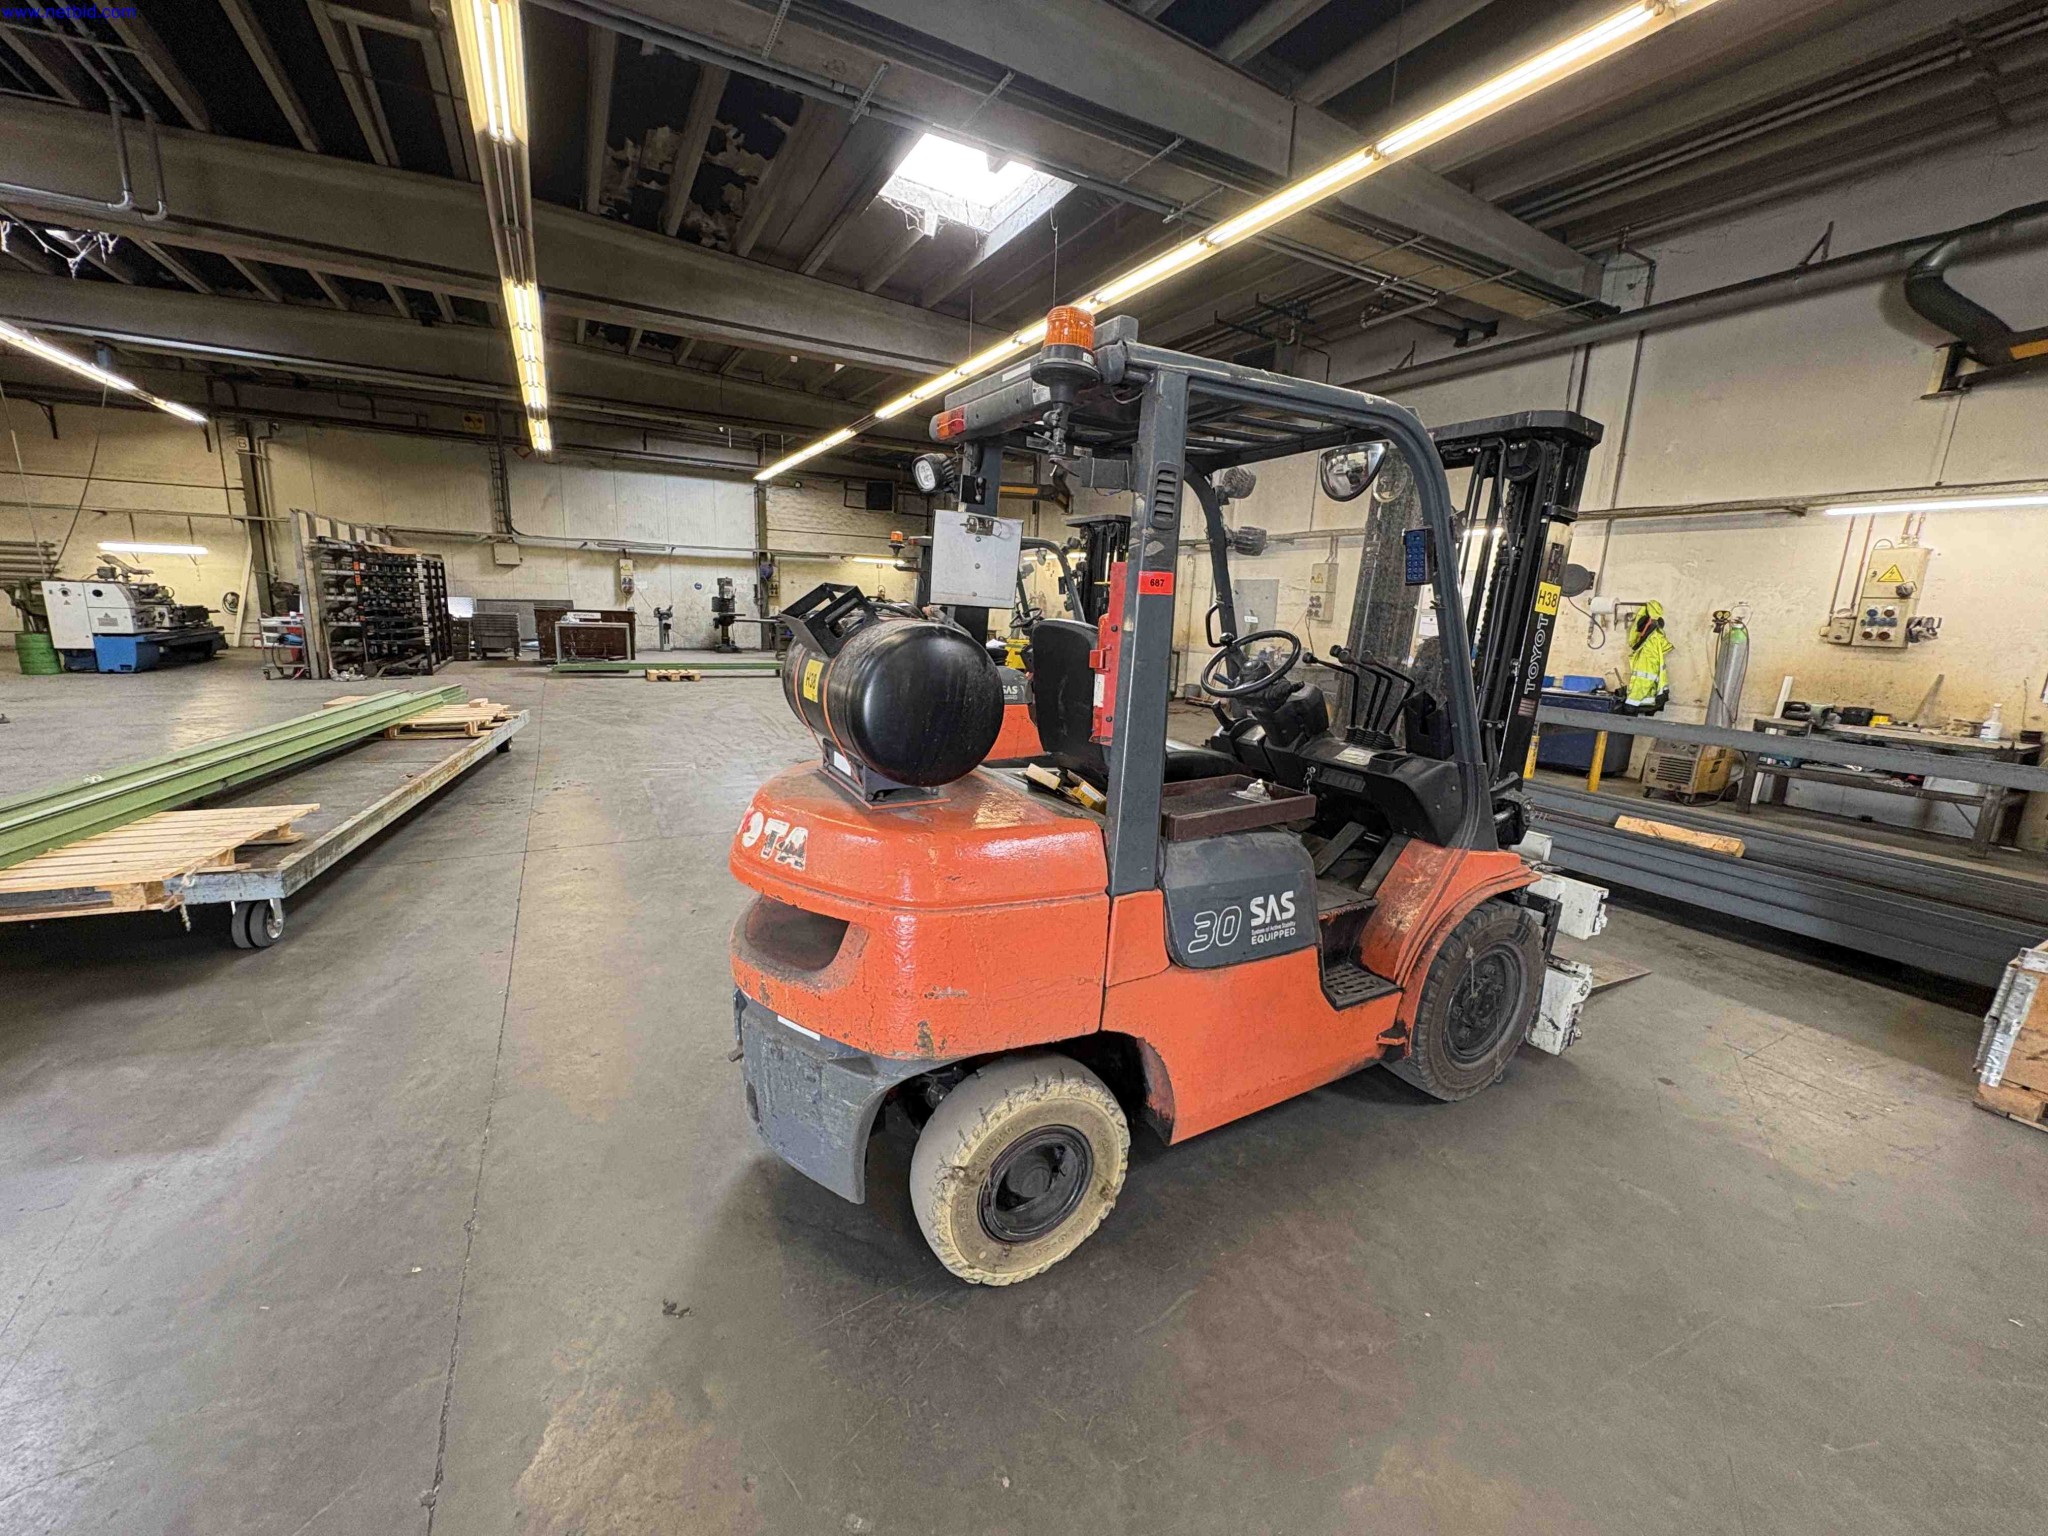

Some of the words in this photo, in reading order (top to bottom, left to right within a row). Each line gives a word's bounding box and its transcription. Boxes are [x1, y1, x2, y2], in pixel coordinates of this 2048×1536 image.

[1149, 578, 1165, 588] 687
[1537, 589, 1558, 608] H38
[1523, 613, 1549, 695] TOYOT
[1249, 890, 1296, 927] SAS
[1187, 905, 1242, 954] 30
[1251, 927, 1296, 945] EQUIPPED
